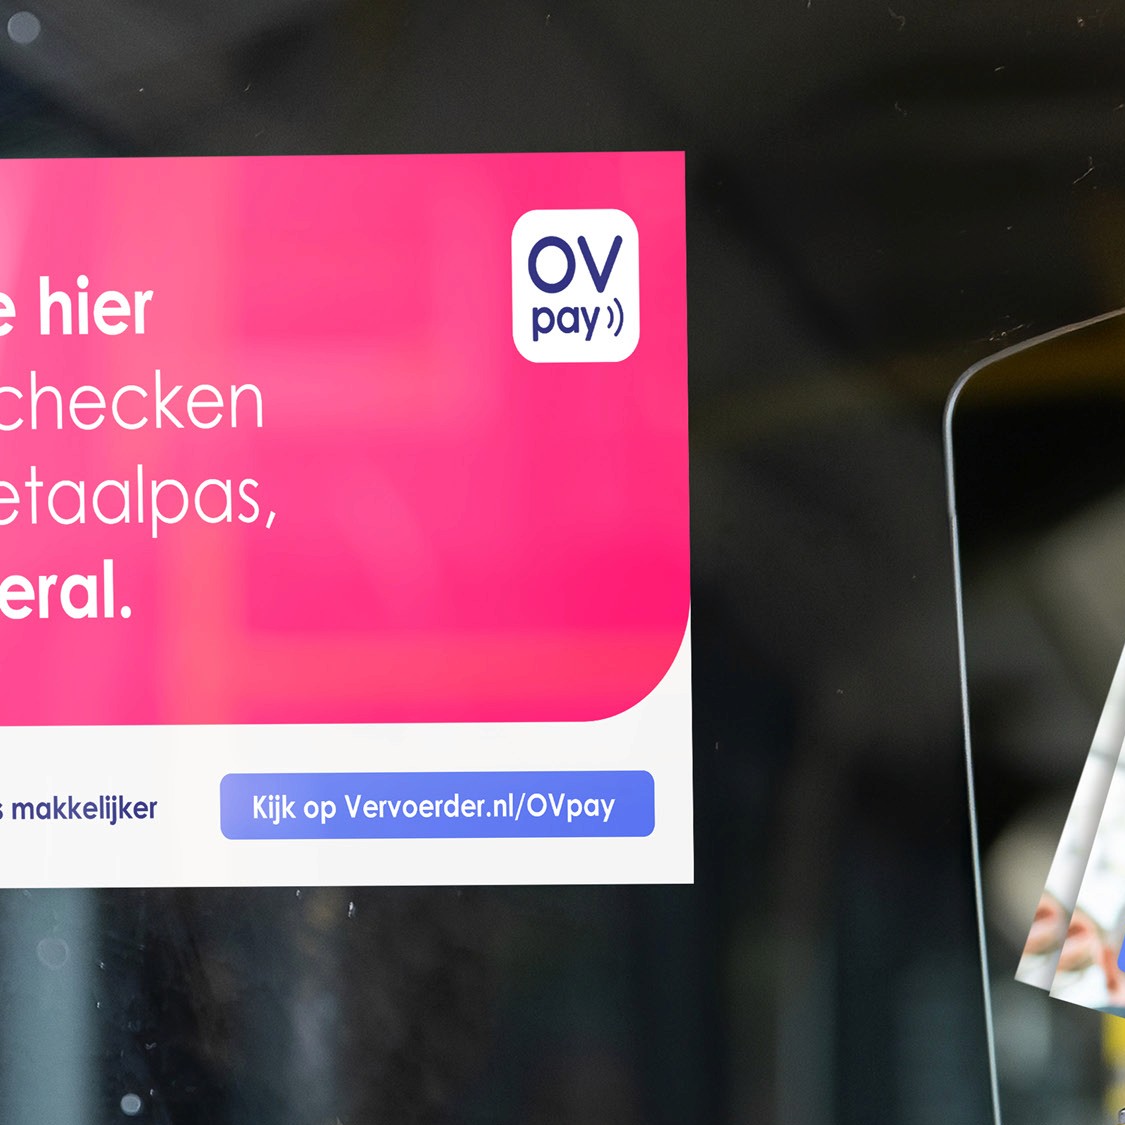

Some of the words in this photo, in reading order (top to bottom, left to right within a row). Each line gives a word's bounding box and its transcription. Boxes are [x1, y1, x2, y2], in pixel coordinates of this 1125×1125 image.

[527, 234, 624, 294] OV
[39, 274, 155, 336] hier
[532, 305, 602, 342] pay
[12, 794, 158, 826] makkelijker
[253, 794, 297, 825] Kijk
[303, 800, 337, 825] op
[344, 792, 615, 823] Vervoerder.nl/OVpay
